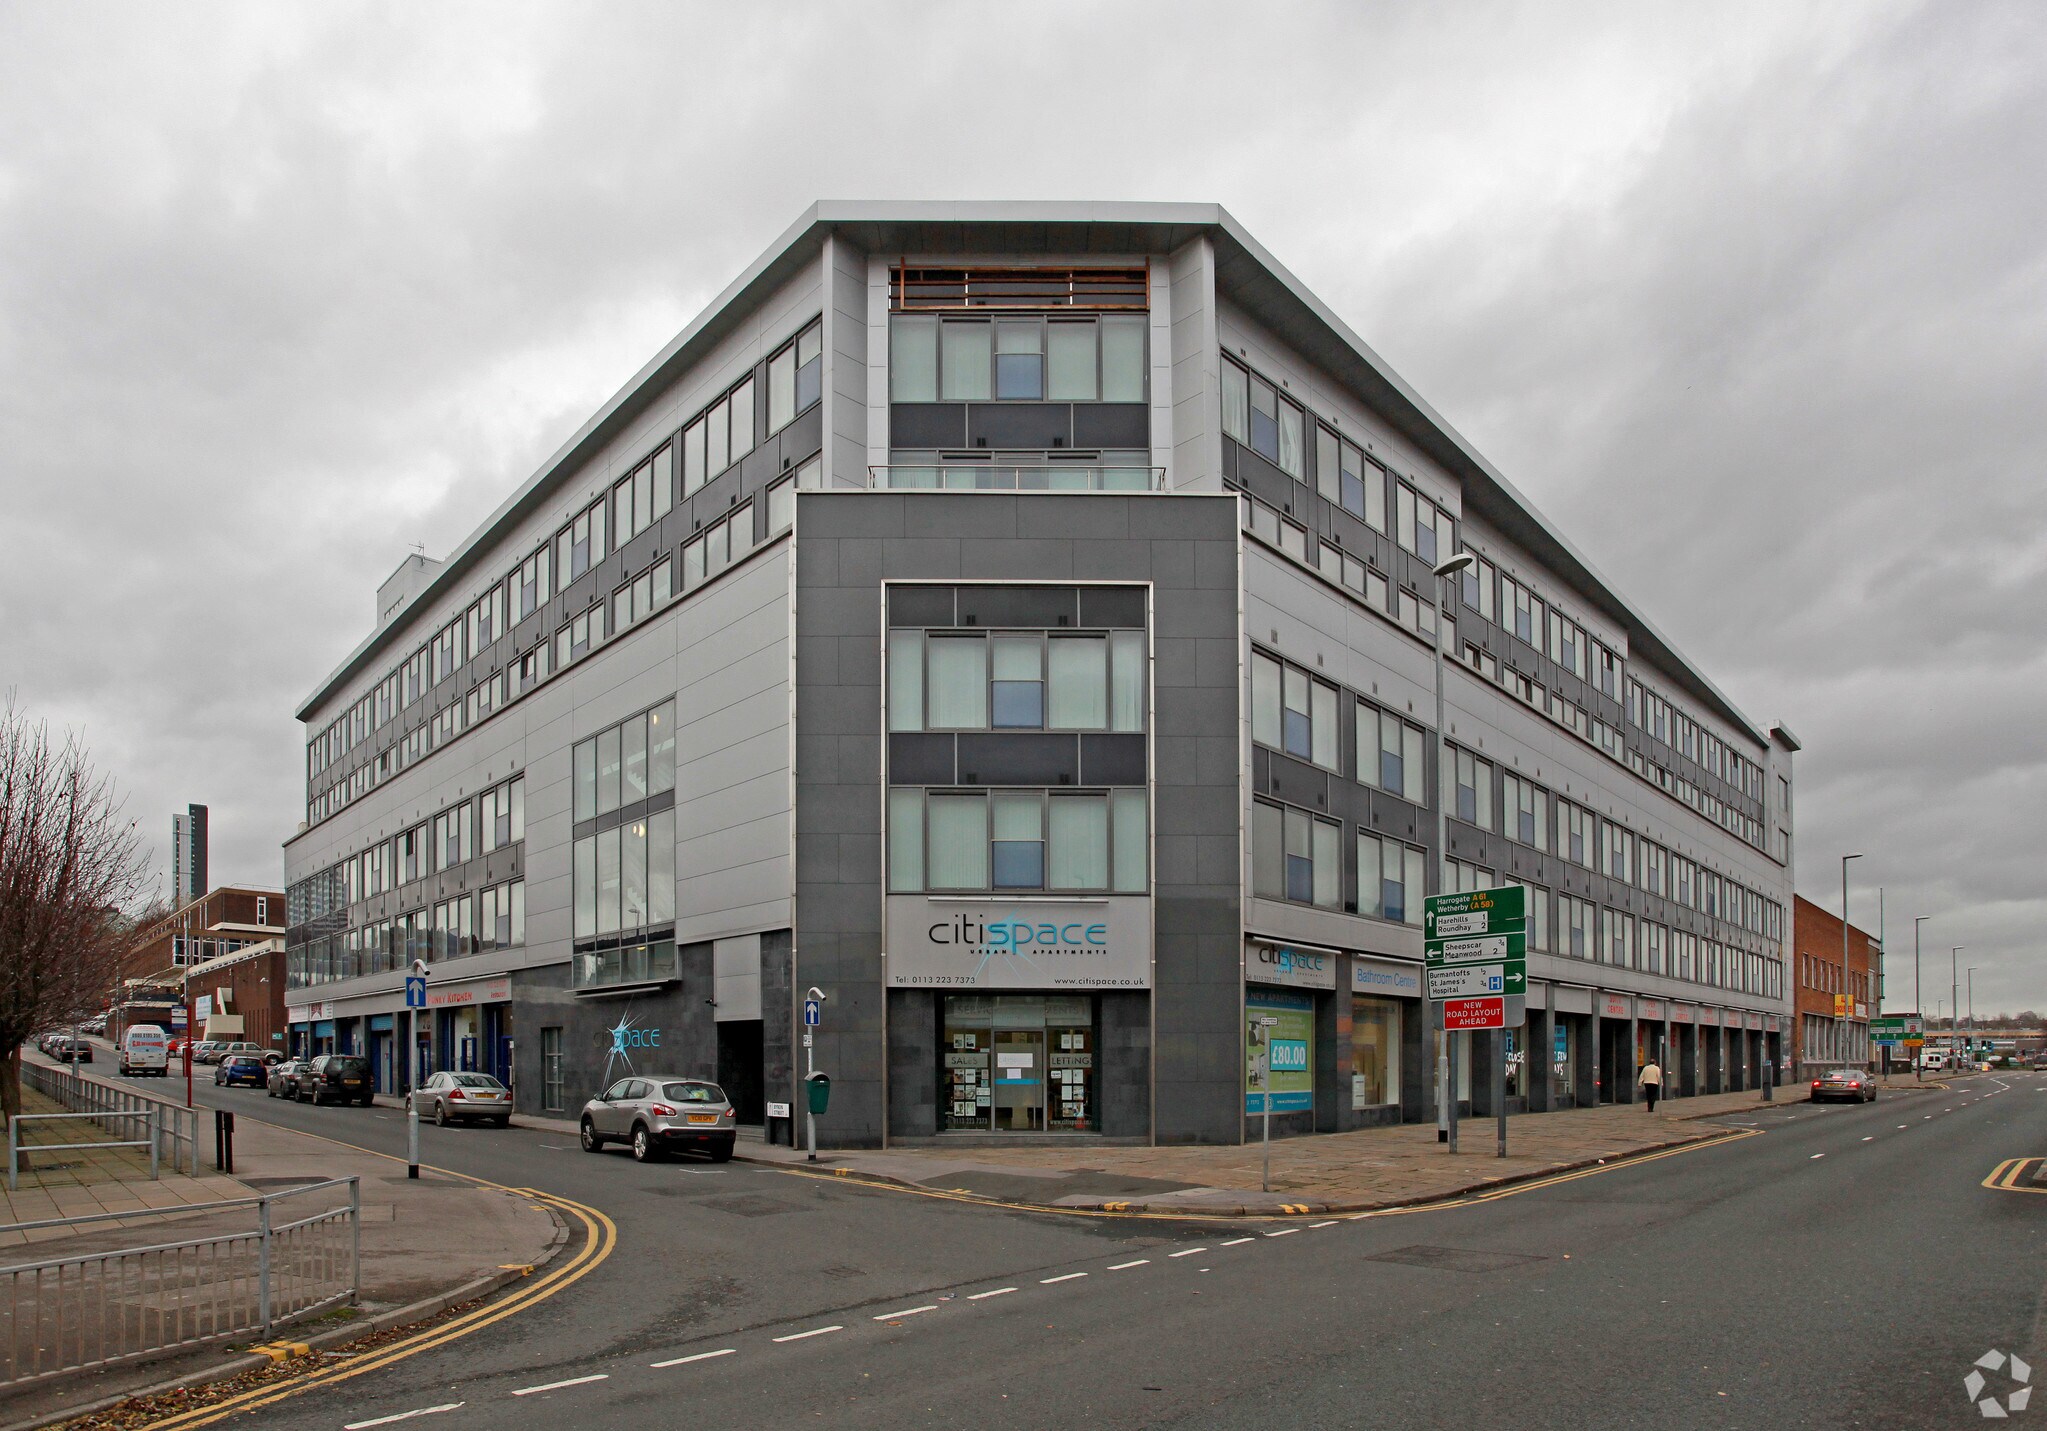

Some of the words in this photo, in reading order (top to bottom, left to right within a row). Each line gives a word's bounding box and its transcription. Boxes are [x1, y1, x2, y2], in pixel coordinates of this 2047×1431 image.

[1437, 896, 1470, 906] Harrogate
[1437, 903, 1469, 913] Wetherby
[1481, 900, 1494, 908] 58)
[1438, 916, 1469, 925] Harehills
[1438, 924, 1472, 933] Roundhay
[928, 913, 1106, 955] citispace
[1445, 942, 1482, 951] Sheepscar
[1259, 943, 1323, 973] citispace
[1445, 950, 1482, 959] Meanwood
[1357, 968, 1393, 985] Bathroom
[1394, 973, 1417, 988] Centre
[1430, 969, 1471, 979] Burmantofts
[895, 976, 909, 984] Tel:
[912, 976, 933, 984] 0113
[936, 976, 951, 984] 223
[954, 976, 976, 984] 7373
[1054, 977, 1145, 987] www.citispace.co.uk
[1440, 978, 1466, 987] James's
[1490, 977, 1500, 989] H
[1433, 986, 1459, 995] Hospital
[1447, 1010, 1468, 1018] ROAD
[1470, 1009, 1501, 1017] LAYOUT
[1272, 1045, 1306, 1066] £80.00
[951, 1056, 978, 1065] SALES
